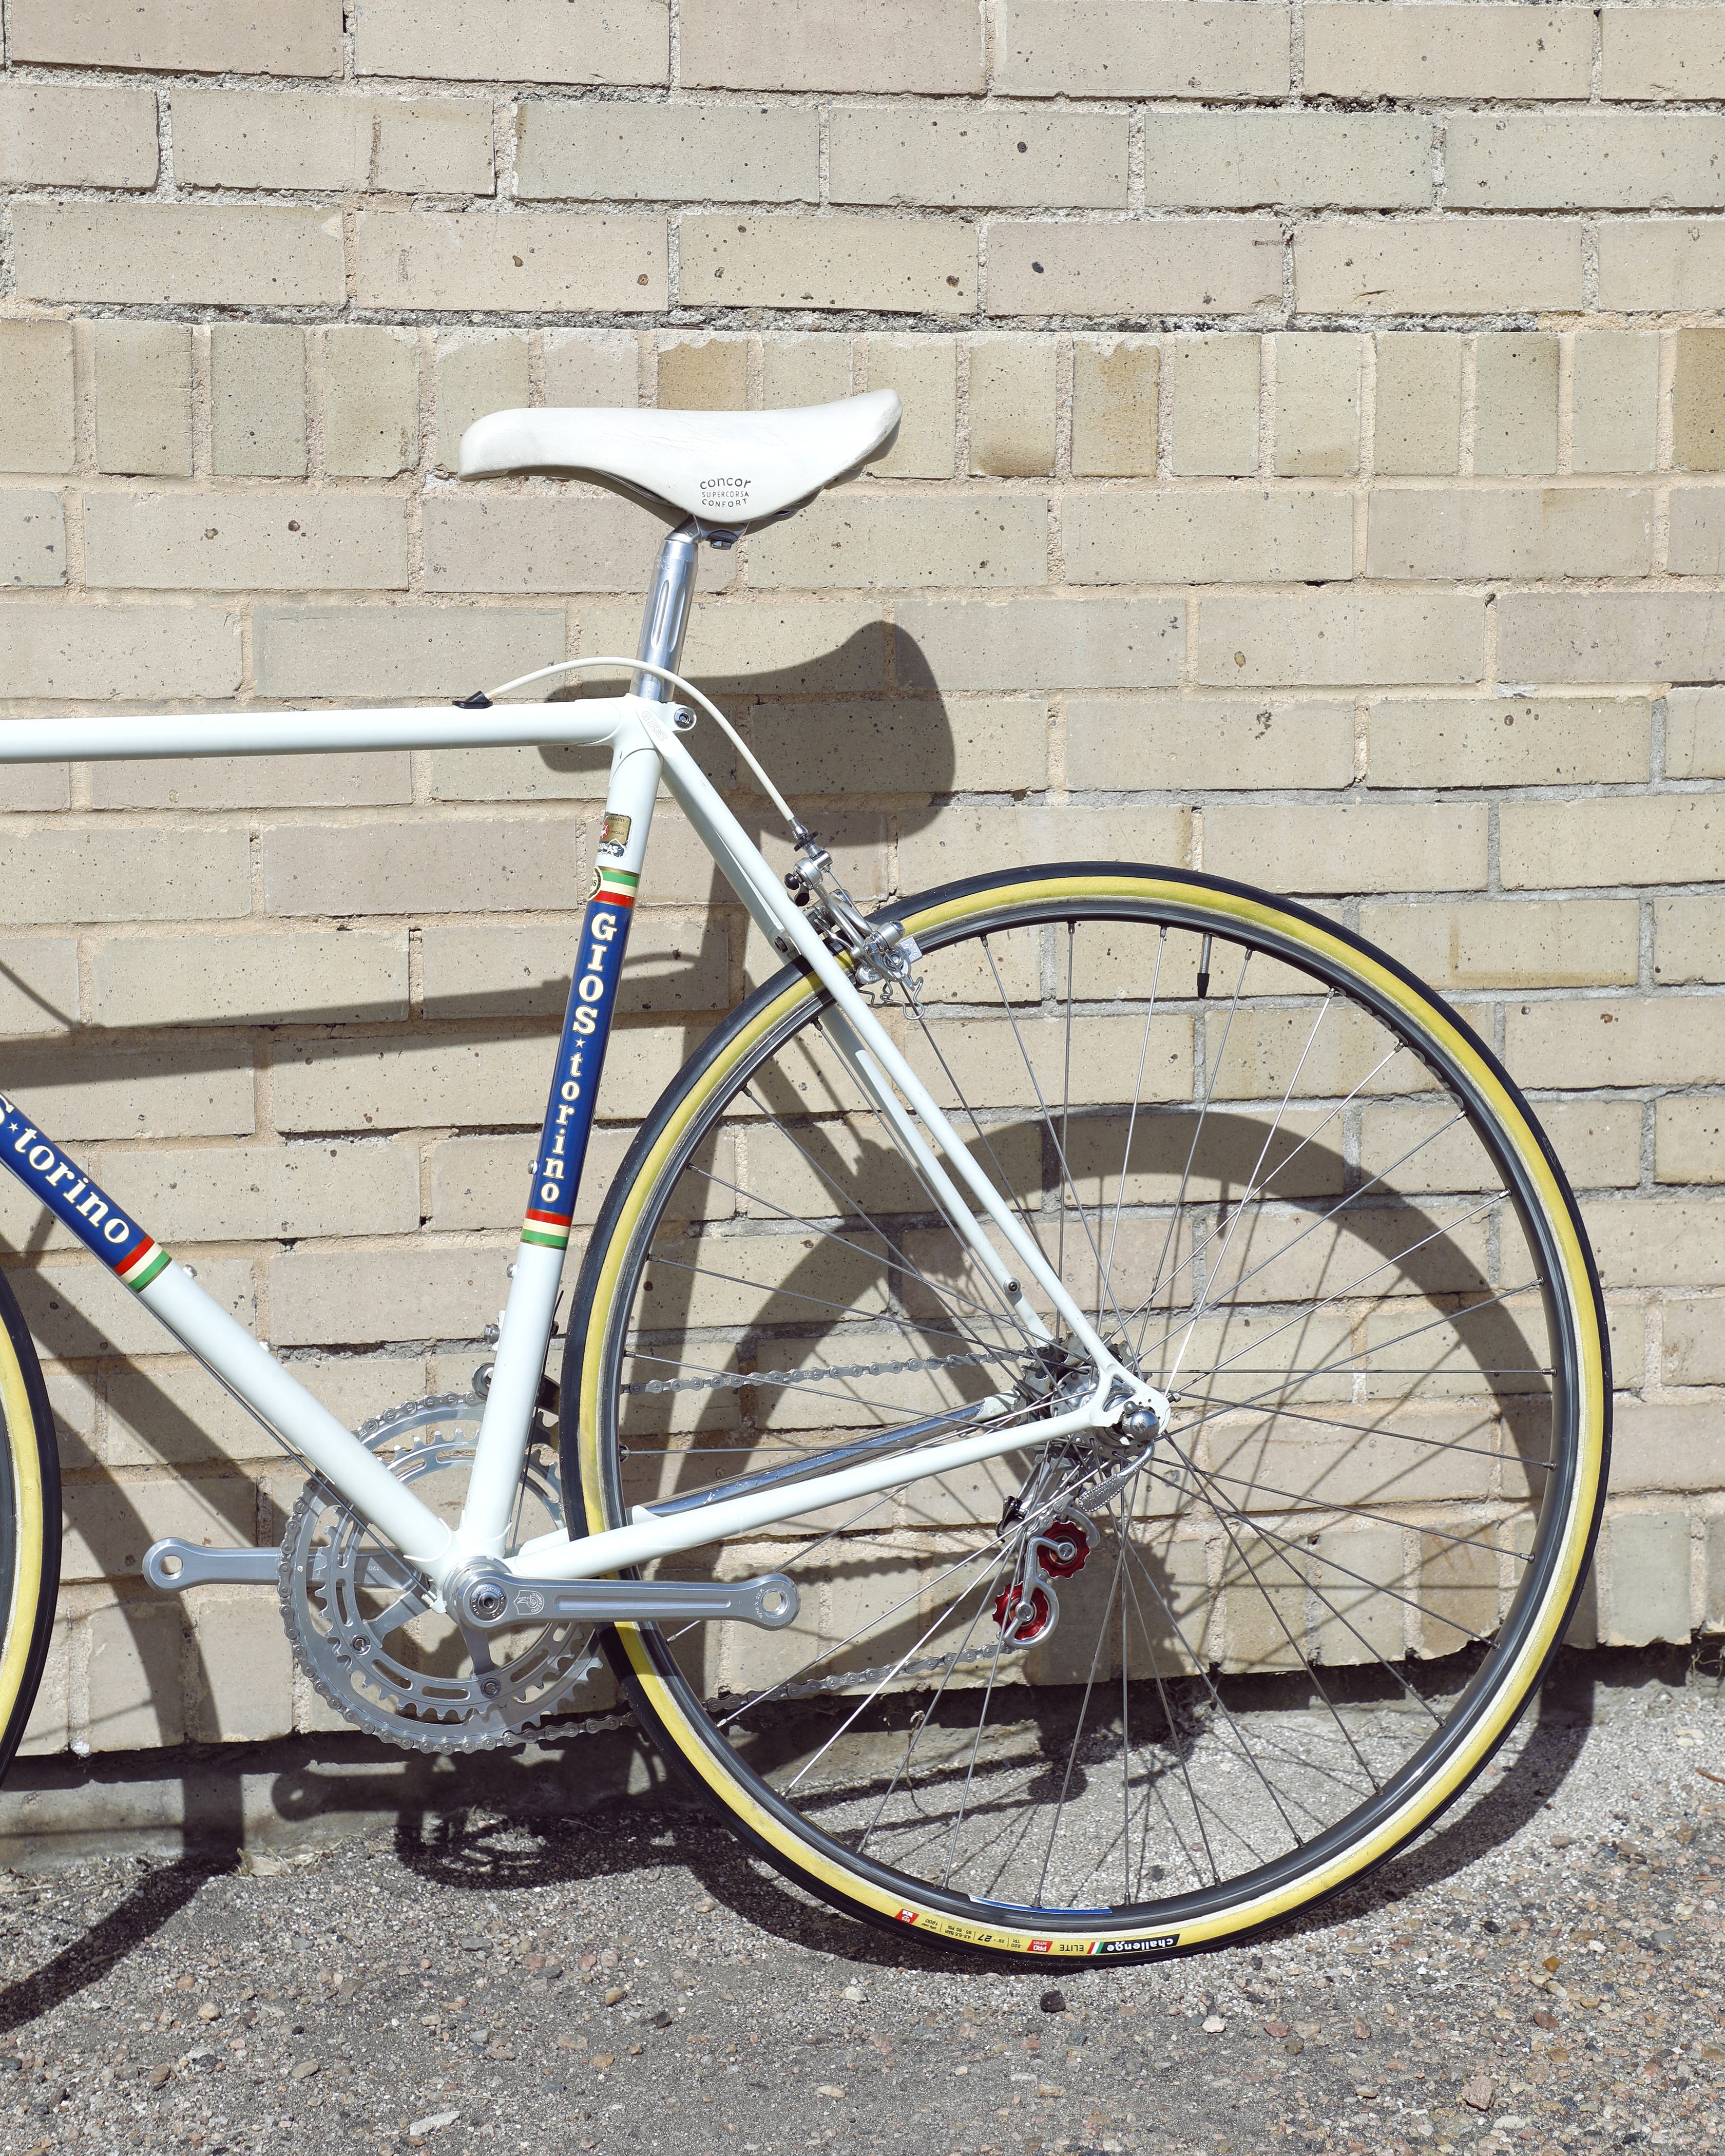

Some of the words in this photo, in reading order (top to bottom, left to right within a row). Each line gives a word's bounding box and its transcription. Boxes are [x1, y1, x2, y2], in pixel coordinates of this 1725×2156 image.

[700, 477, 751, 490] concor
[702, 498, 747, 508] CONFORT
[641, 710, 668, 741] GIOS
[572, 911, 618, 1035] GIOS
[541, 1050, 582, 1203] torino
[14, 1127, 130, 1244] torino
[977, 1934, 992, 1942] 27
[1106, 1938, 1174, 1952] challenge
